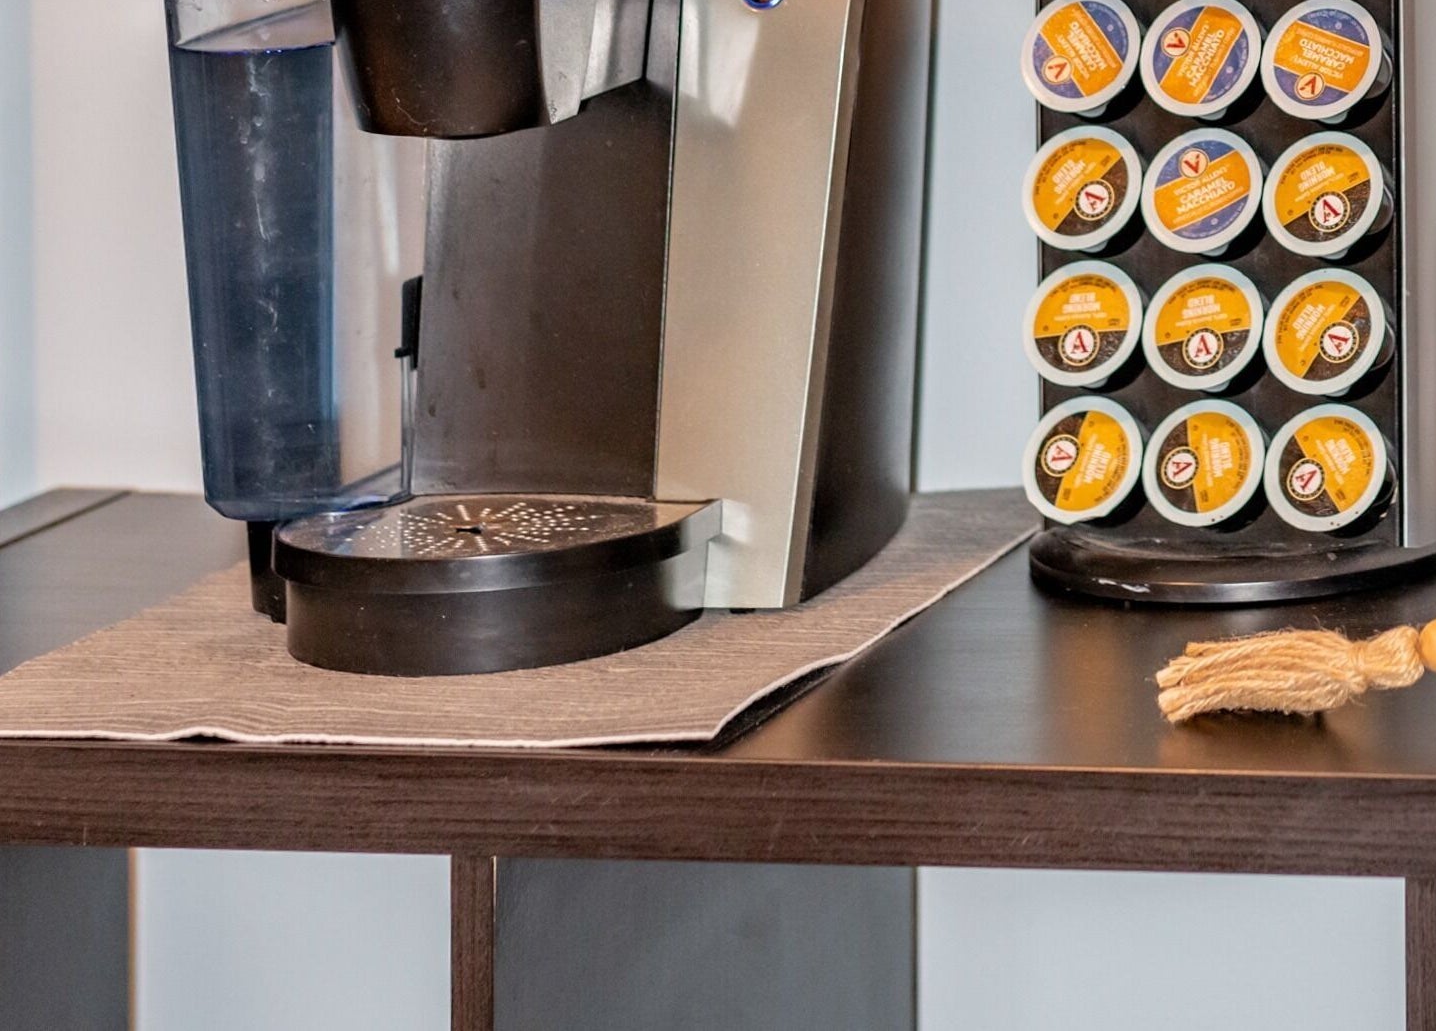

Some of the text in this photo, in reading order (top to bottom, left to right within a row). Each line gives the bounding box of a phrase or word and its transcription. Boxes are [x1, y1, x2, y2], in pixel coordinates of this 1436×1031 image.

[1065, 30, 1098, 71] CARAMEL
[1069, 19, 1107, 70] MACCHIATO
[1185, 31, 1217, 79] CARAMEL
[1188, 28, 1226, 87] MACCHIATO
[1298, 37, 1354, 63] MACCHIATO
[1300, 47, 1345, 69] CARAMEL
[1176, 180, 1236, 214] MACCHIATO
[1179, 176, 1226, 204] CARAMEL
